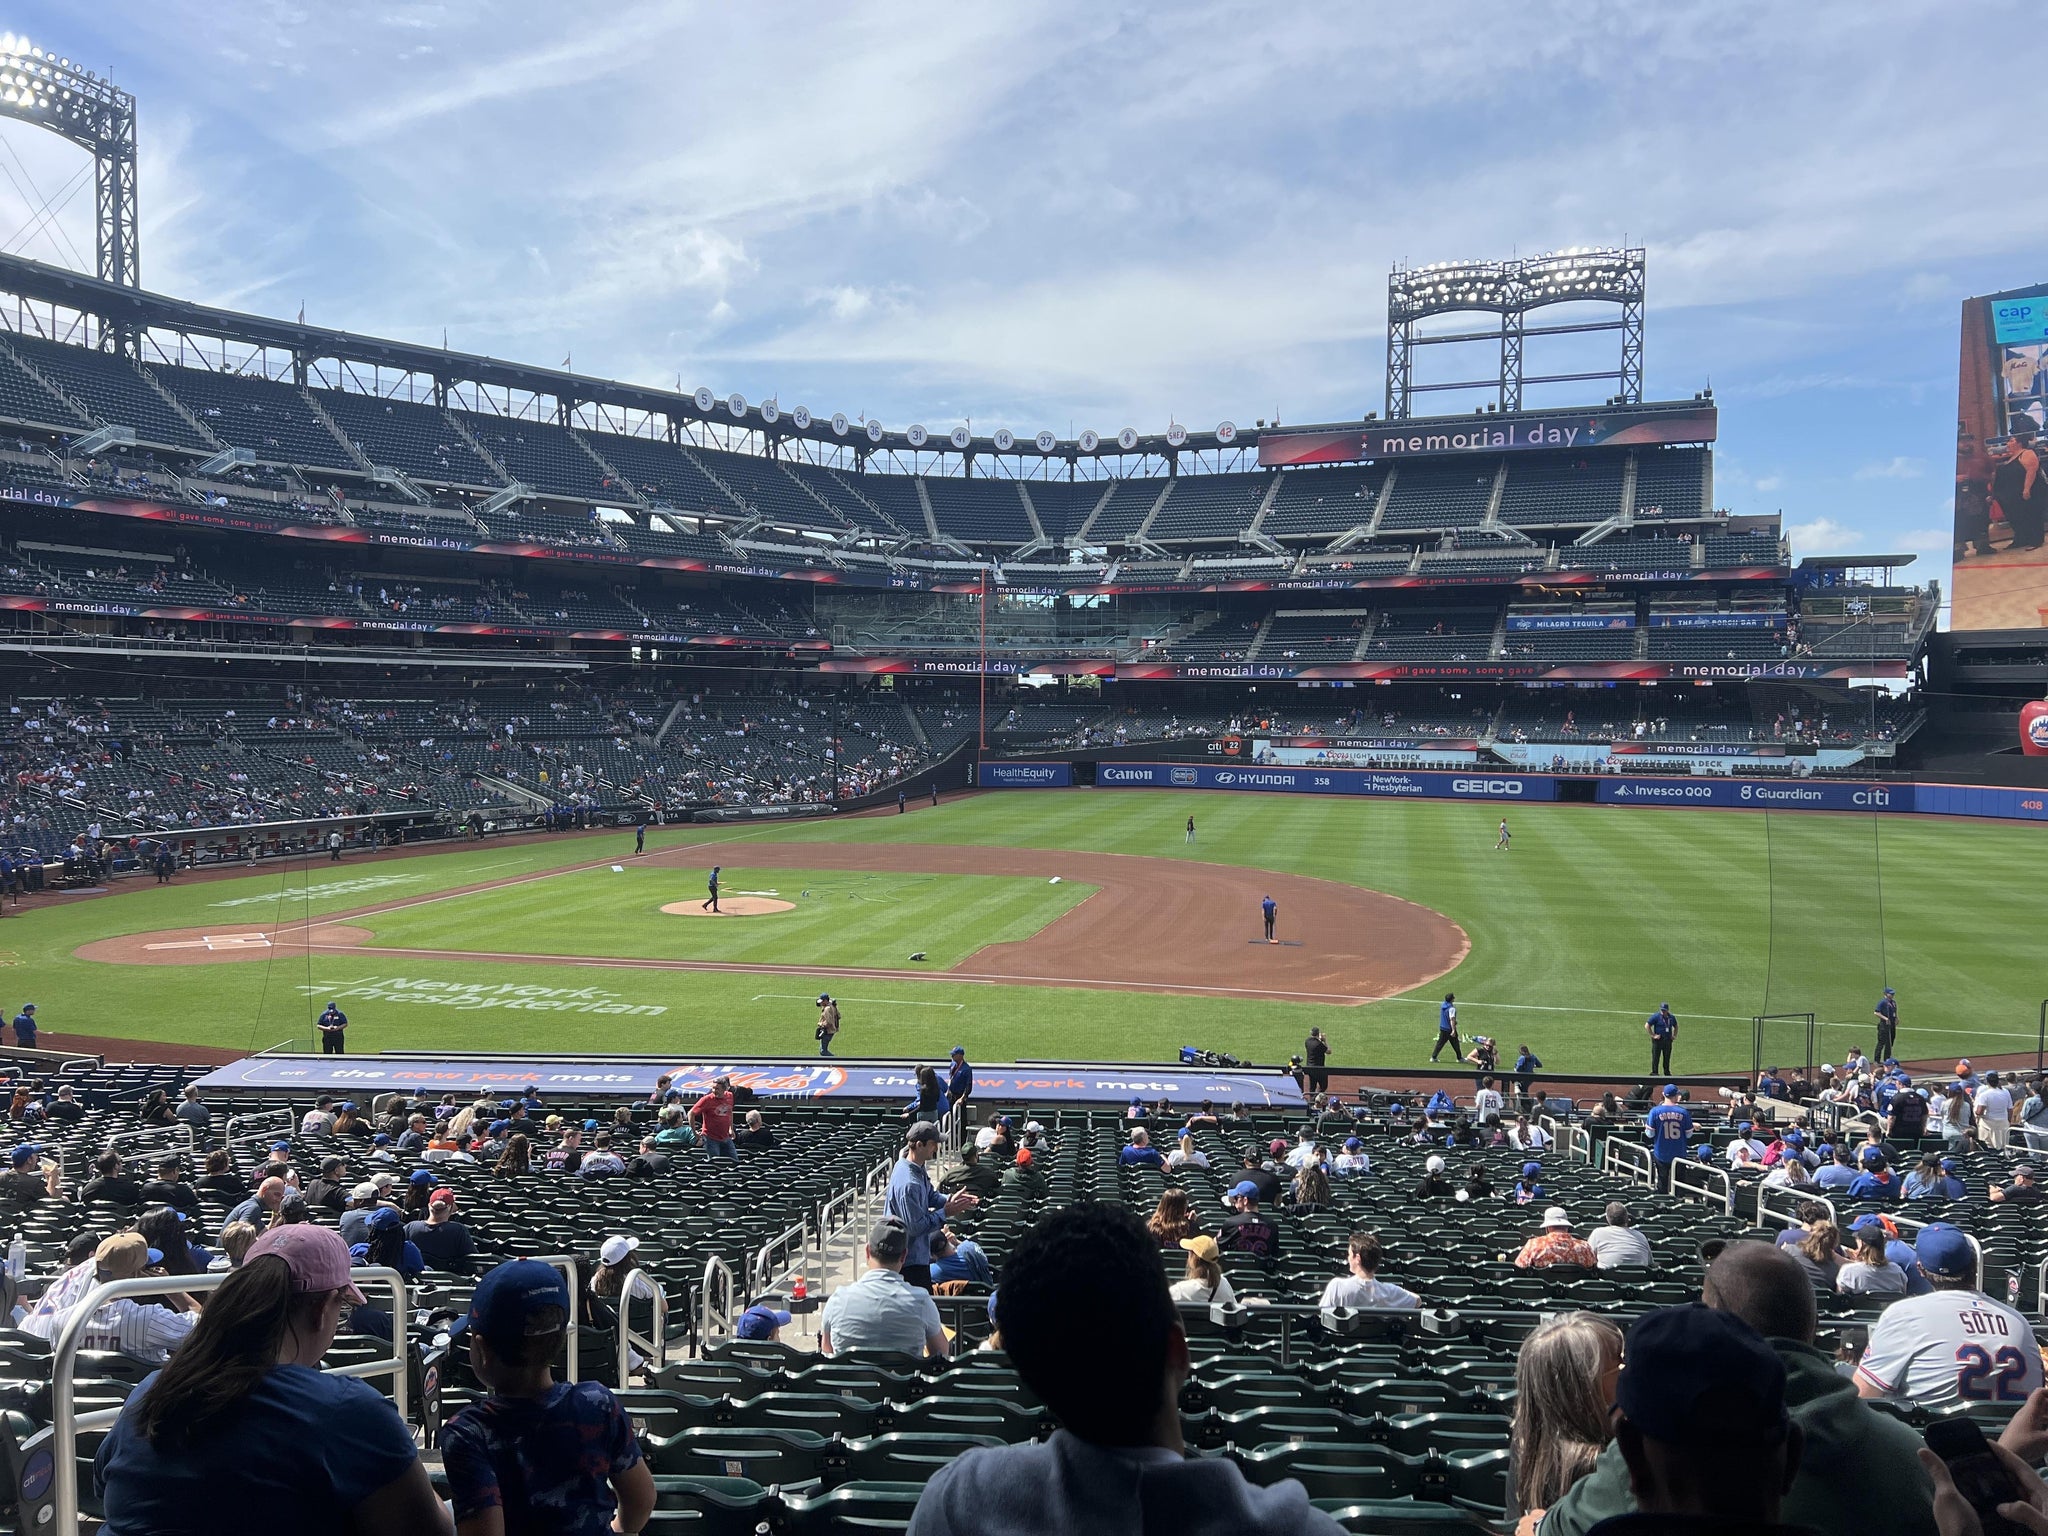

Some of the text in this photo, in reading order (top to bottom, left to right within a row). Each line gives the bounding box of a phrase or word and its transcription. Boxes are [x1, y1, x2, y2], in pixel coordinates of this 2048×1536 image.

[1999, 306, 2032, 319] cap
[701, 394, 708, 405] 5
[733, 400, 742, 411] 18
[766, 406, 775, 417] 16
[797, 412, 807, 423] 24
[836, 419, 844, 430] 17
[869, 426, 880, 436] 36
[912, 430, 922, 441] 31
[1219, 427, 1232, 437] 42
[955, 433, 965, 443] 41
[1000, 435, 1008, 445] 14
[1040, 437, 1052, 447] 37
[1383, 423, 1579, 453] memorial day
[0, 487, 61, 507] rial day
[180, 513, 199, 521] gave
[230, 520, 251, 528] some
[254, 522, 273, 530] gave
[380, 534, 462, 550] memorial day
[714, 564, 774, 577] memorial day
[1604, 571, 1683, 581] memorial day
[1278, 579, 1345, 589] memorial day
[996, 586, 1057, 595] memorial day
[55, 602, 131, 615] memorial day
[362, 621, 428, 632] memorial day
[632, 633, 683, 643] memorial day
[924, 661, 1017, 673] memorial day
[1187, 665, 1284, 678] memorial day
[1395, 666, 1408, 674] all
[1411, 667, 1437, 676] gave
[1440, 667, 1472, 675] some,
[1508, 667, 1534, 676] gave
[1683, 663, 1807, 678] memorial day
[1229, 741, 1239, 749] 22
[1337, 739, 1408, 748] memorial day
[1656, 744, 1740, 755] memorial day
[993, 767, 1055, 779] HealthEquity
[1103, 768, 1153, 780] Canon
[1372, 774, 1412, 783] NewYork-
[1238, 774, 1295, 785] HYUNDAI
[1314, 777, 1330, 786] 358
[1372, 784, 1423, 794] Presbyterian
[1452, 779, 1523, 794] GEICO
[1635, 785, 1712, 798] Invesco QQQ
[1755, 787, 1822, 800] Guardian
[1852, 789, 1890, 805] citi
[2020, 800, 2044, 810] 408
[376, 977, 622, 999] NewYork-
[331, 988, 669, 1016] Presbyterian
[331, 1069, 386, 1079] the
[392, 1071, 465, 1080] new
[467, 1071, 544, 1083] york
[548, 1073, 634, 1083] mets
[1014, 1078, 1086, 1091] york
[1096, 1080, 1180, 1091] mets
[1485, 1099, 1497, 1109] 20
[1663, 1121, 1681, 1140] 16
[1959, 1310, 2009, 1336] SOTO
[79, 1335, 121, 1351] OTO
[1954, 1342, 2030, 1401] 22
